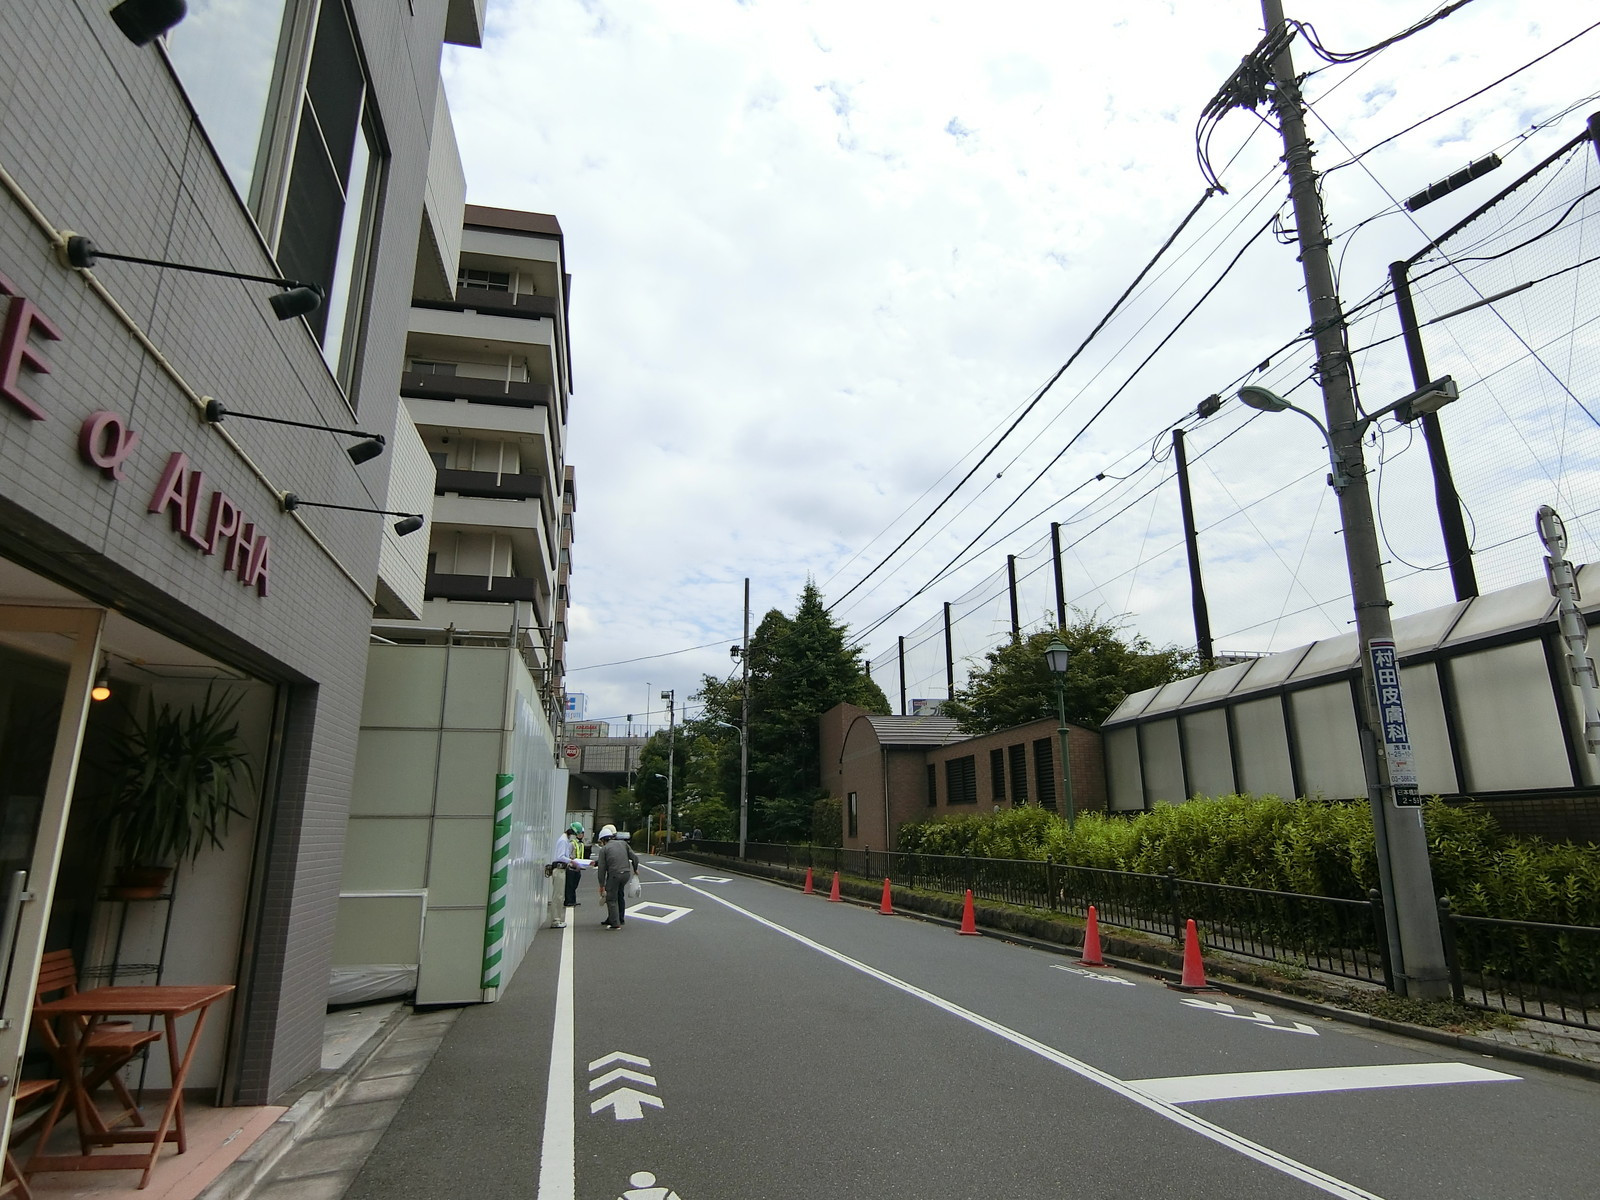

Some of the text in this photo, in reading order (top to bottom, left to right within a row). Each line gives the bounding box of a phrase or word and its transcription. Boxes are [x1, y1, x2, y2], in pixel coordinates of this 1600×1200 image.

[148, 451, 272, 598] ALPHA
[1375, 649, 1407, 743] 村田皮膚科
